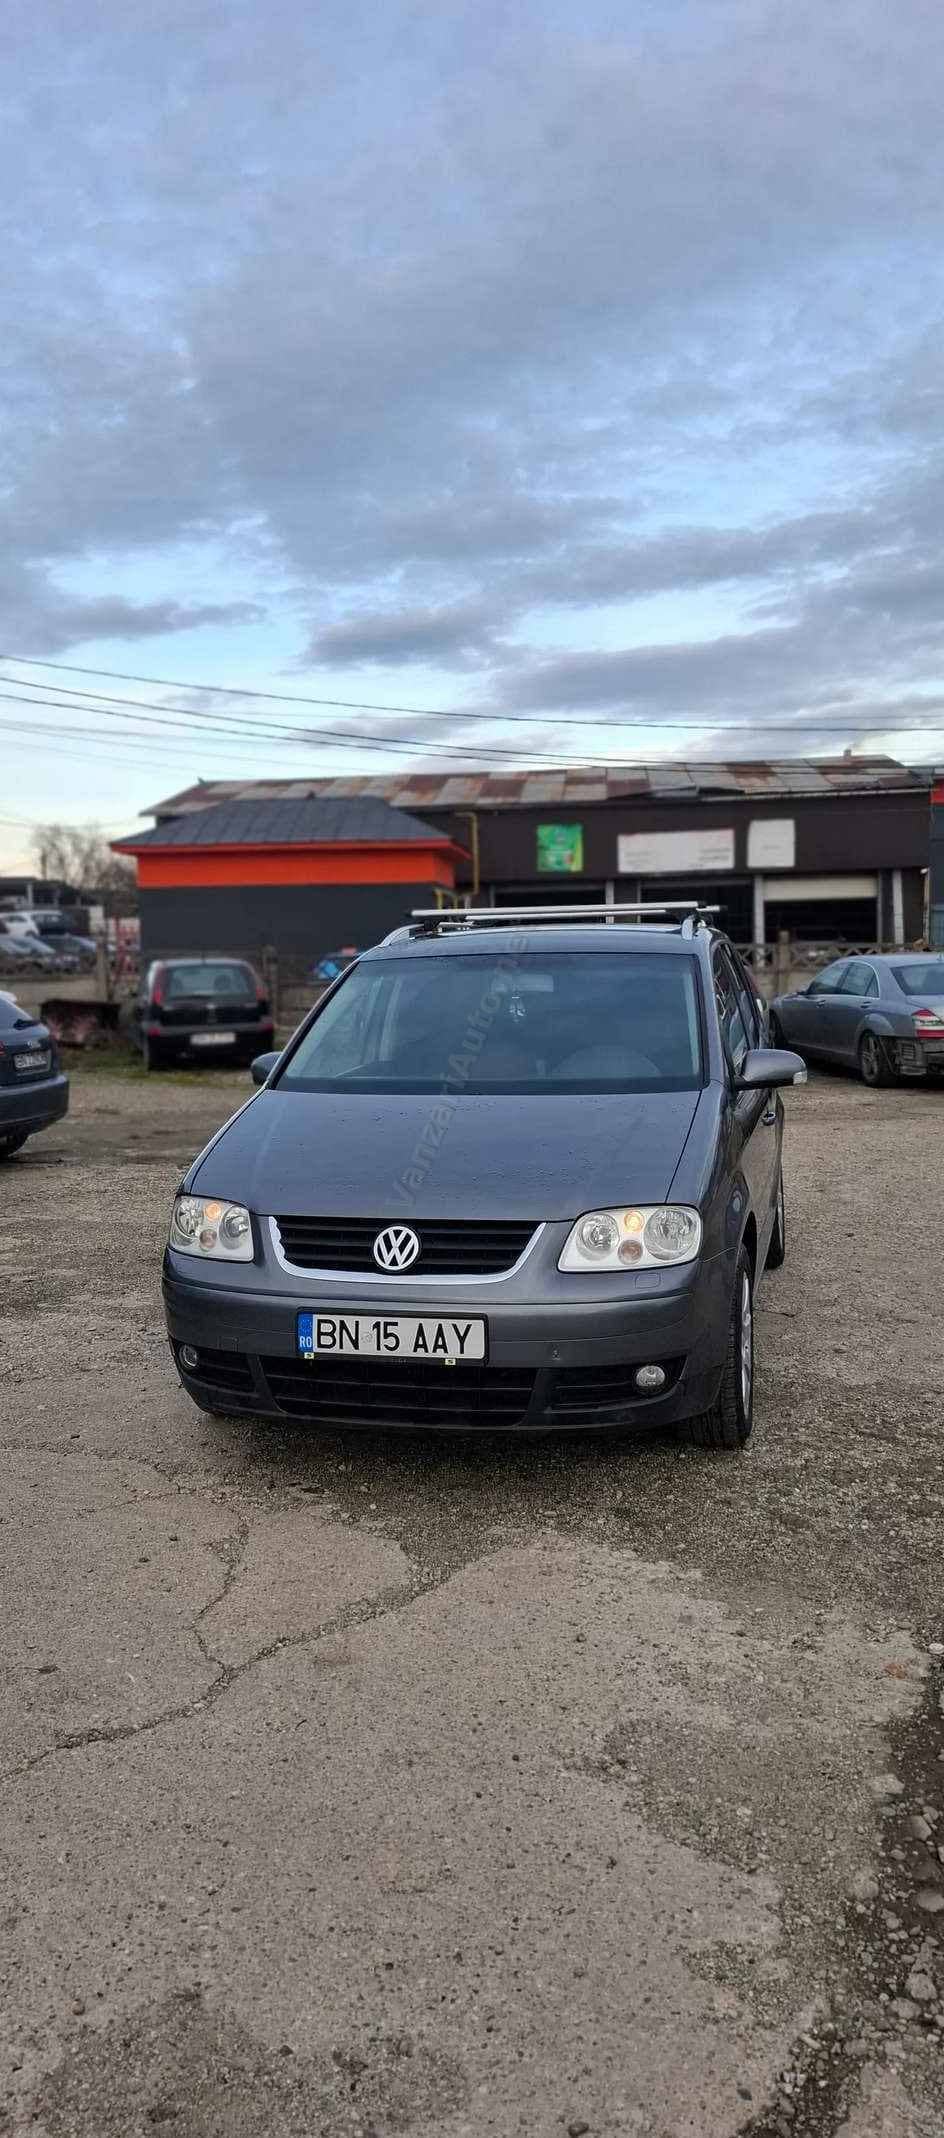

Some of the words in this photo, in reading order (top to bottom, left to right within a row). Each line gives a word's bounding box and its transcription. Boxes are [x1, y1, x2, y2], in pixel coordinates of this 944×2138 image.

[375, 1226, 418, 1270] VW
[299, 1335, 312, 1348] RO
[316, 1319, 359, 1351] BN
[372, 1320, 400, 1352] 15
[413, 1323, 472, 1354] AAY
